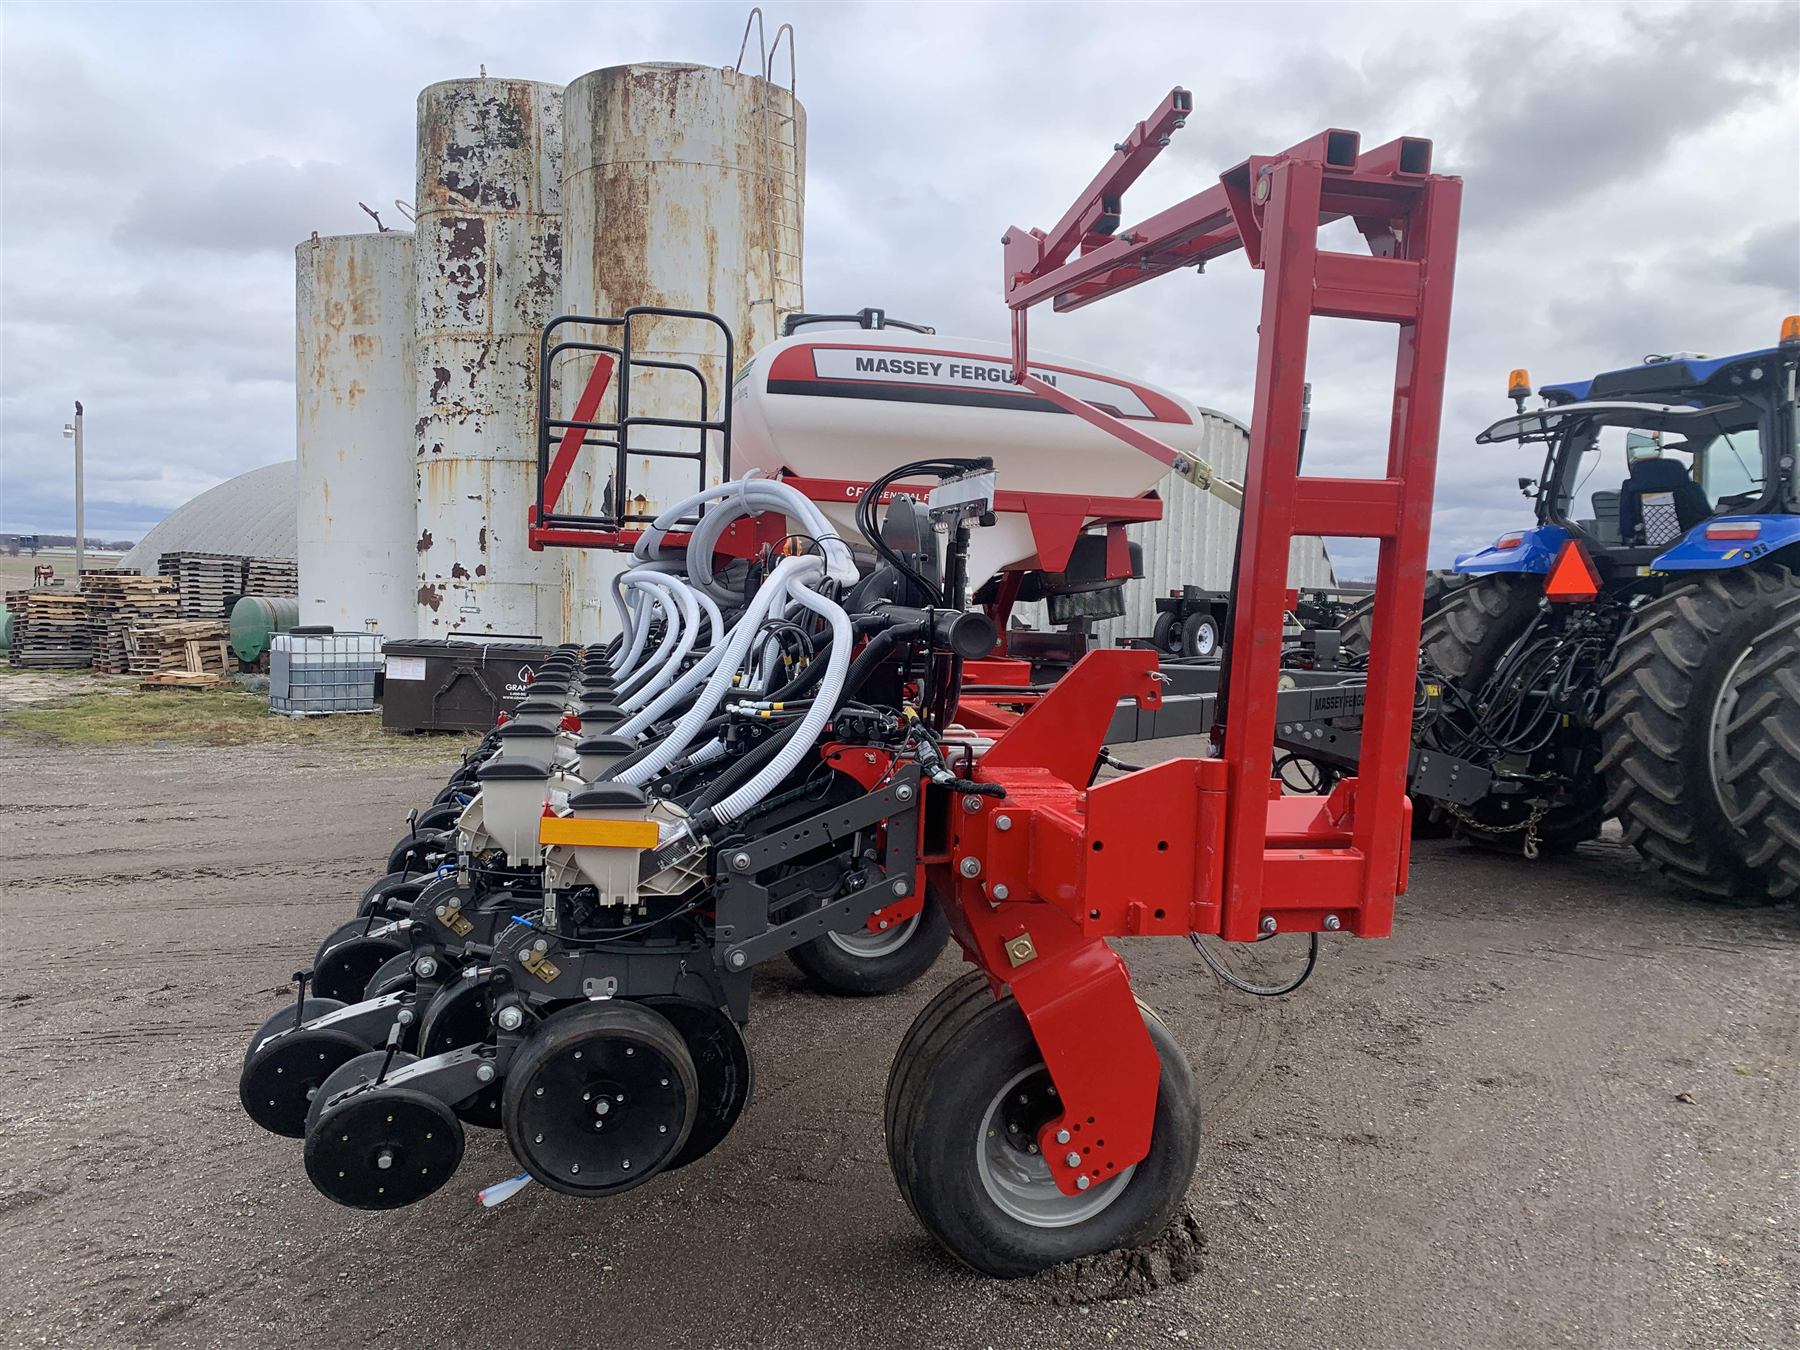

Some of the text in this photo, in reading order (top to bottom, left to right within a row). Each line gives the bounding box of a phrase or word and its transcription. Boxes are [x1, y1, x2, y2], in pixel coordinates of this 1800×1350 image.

[855, 357, 1056, 387] MASSEY FERGUN
[846, 486, 869, 497] CF
[1314, 695, 1345, 711] MASSEY
